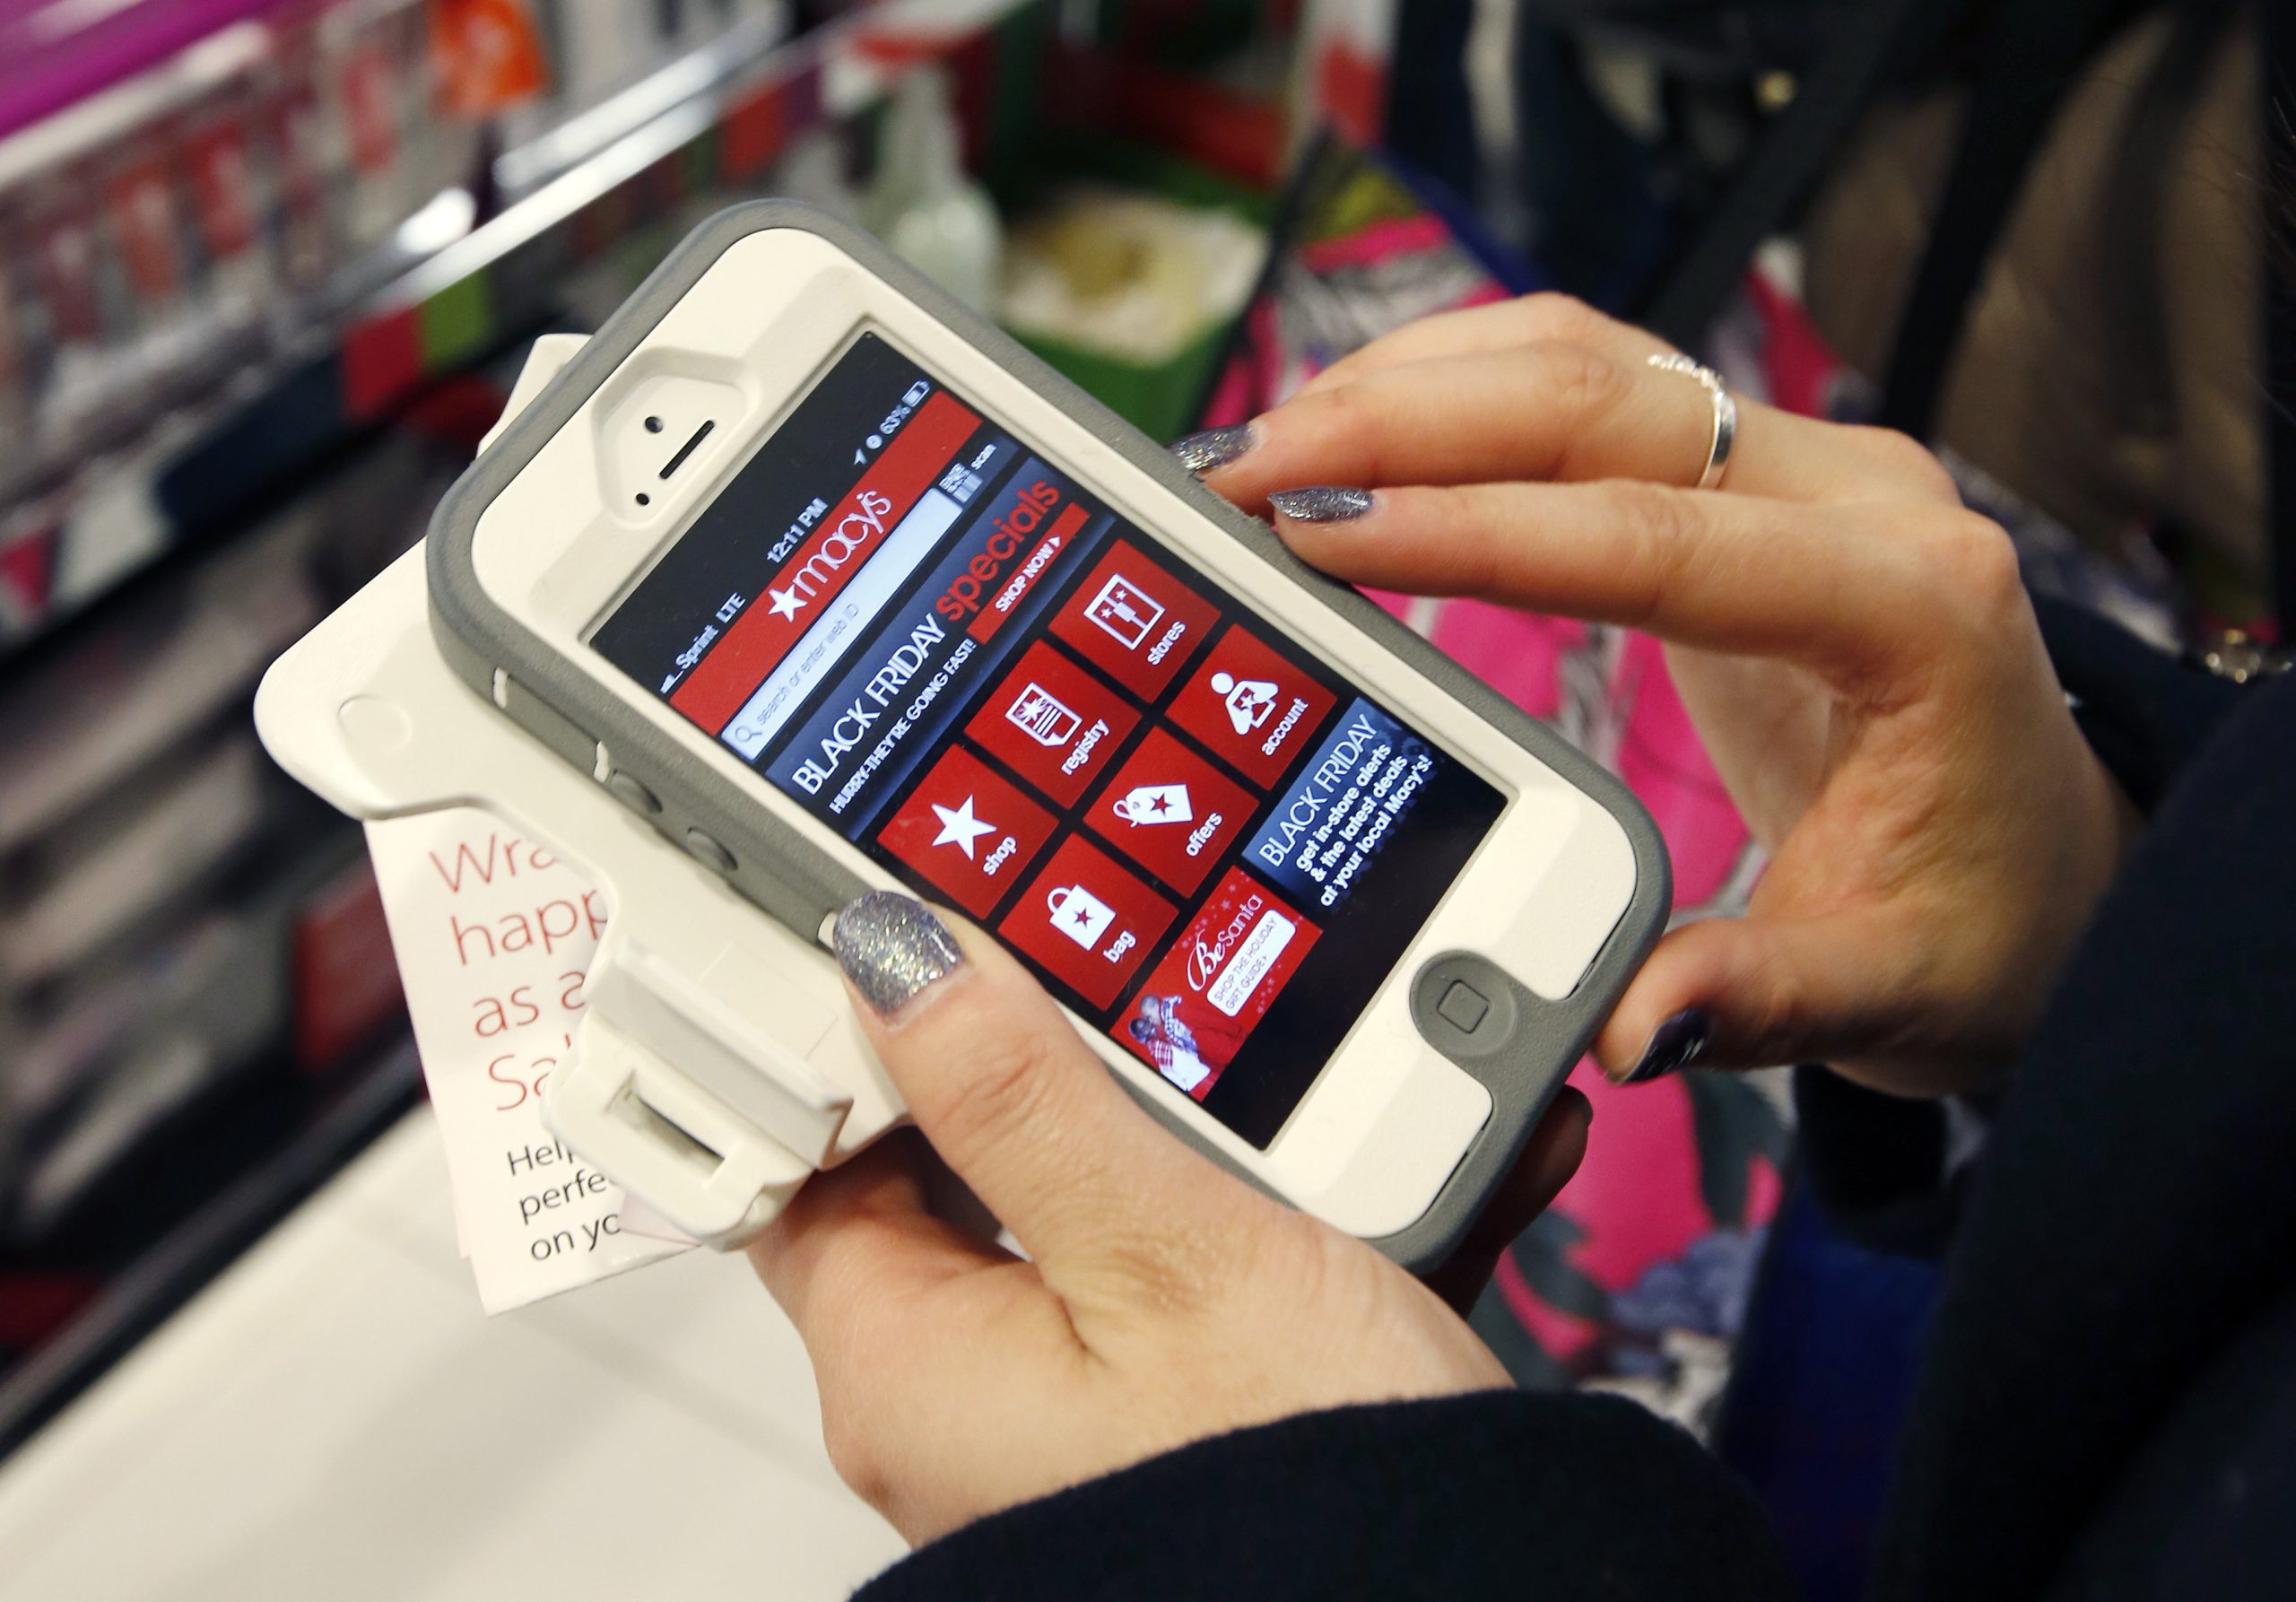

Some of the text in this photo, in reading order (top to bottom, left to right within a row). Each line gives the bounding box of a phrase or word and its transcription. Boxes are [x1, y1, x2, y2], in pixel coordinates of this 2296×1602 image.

[880, 405, 911, 434] 63%
[797, 497, 829, 527] PM
[995, 543, 1055, 612] SHOP NOW
[675, 592, 746, 669] Sprint LTE
[792, 480, 1060, 796] BLACK FRIDAY specials
[1147, 621, 1186, 666] stores
[756, 686, 790, 725] search
[800, 642, 826, 674] enter
[906, 672, 949, 720] GOING
[943, 638, 978, 675] FAST!
[1061, 718, 1109, 775] registry
[1262, 697, 1309, 756] account
[1258, 714, 1378, 867] BLACK FRIDAY
[1296, 743, 1391, 872] get in-store alerts
[1309, 755, 1408, 882] & the latest deals
[982, 835, 1018, 875] shop
[1186, 812, 1223, 856] offers
[1320, 754, 1433, 907] at your local Macy's!
[1103, 930, 1136, 963] bag
[1213, 917, 1278, 1002] SHOP THE HOLIDAY
[473, 986, 539, 1037] as
[1225, 982, 1245, 1009] GIFT
[489, 1033, 571, 1110] Sa
[507, 1140, 574, 1176] Hel
[519, 1169, 607, 1226] perfe
[531, 1231, 575, 1261] on
